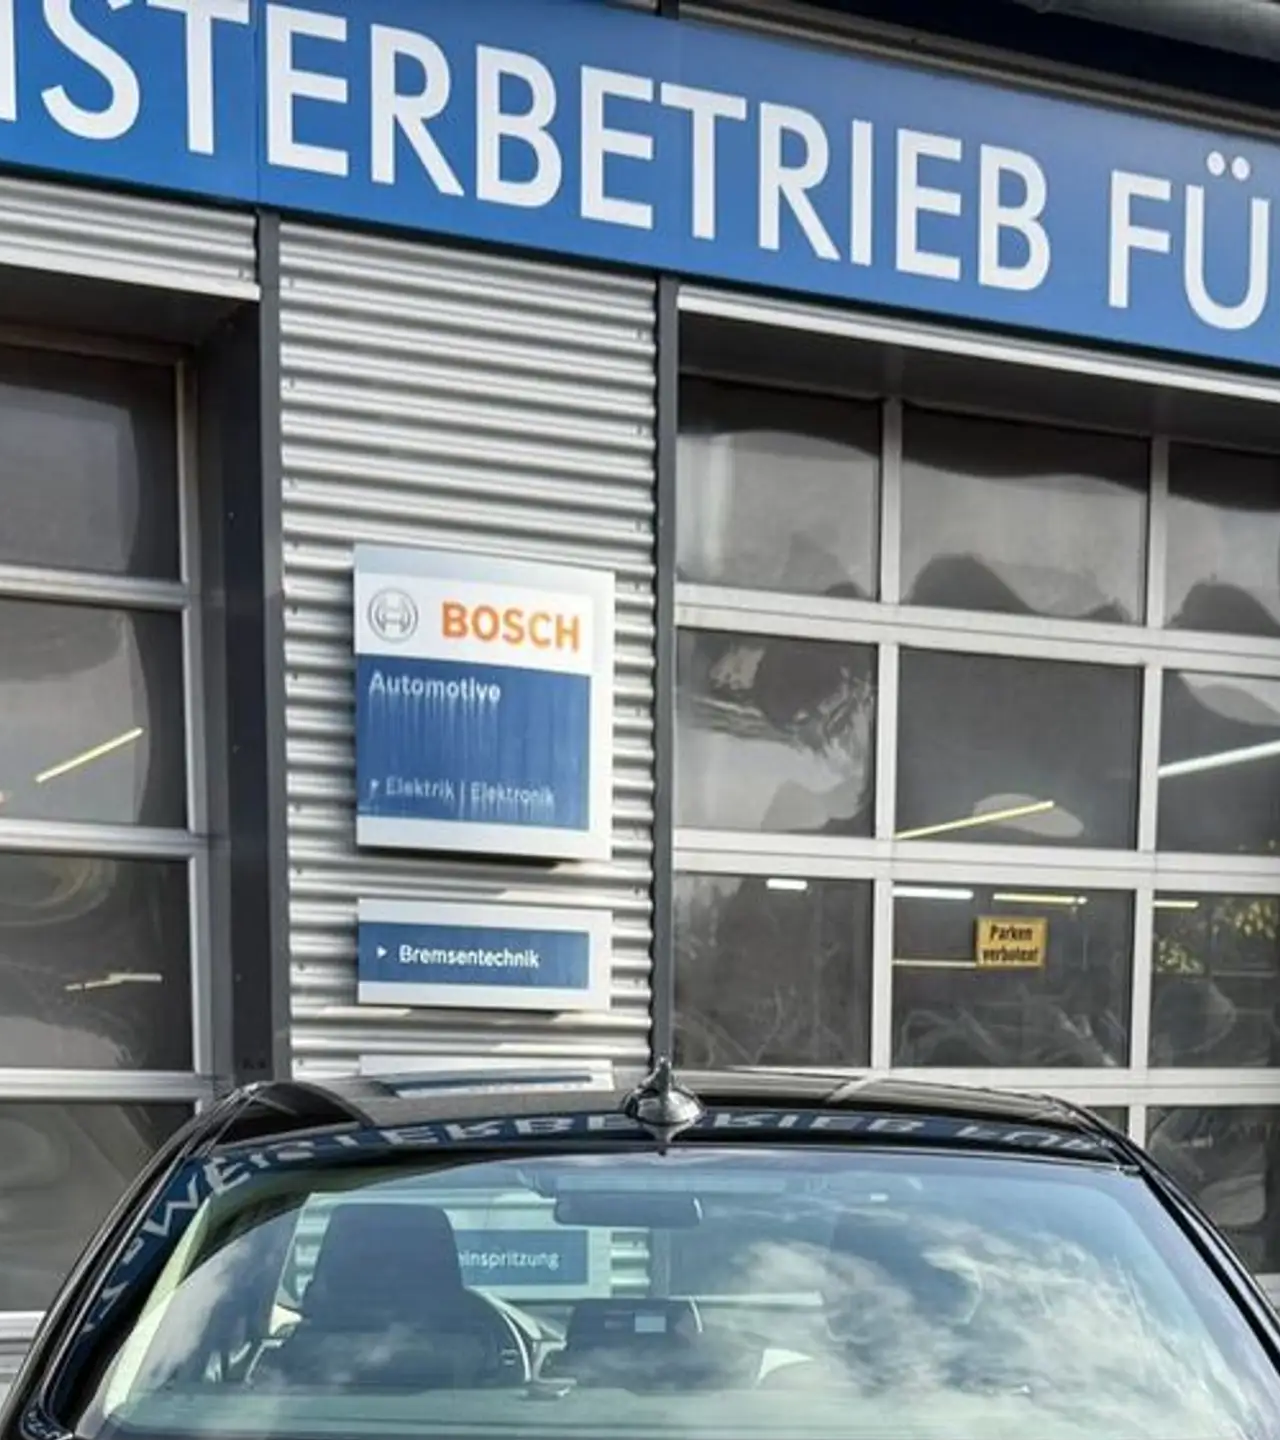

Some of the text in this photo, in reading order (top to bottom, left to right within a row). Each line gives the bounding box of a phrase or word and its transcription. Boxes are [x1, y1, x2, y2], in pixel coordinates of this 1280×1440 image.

[442, 601, 580, 652] BOSCH
[369, 669, 501, 702] Automotive
[385, 777, 555, 808] Elektrik Elektronik
[990, 924, 1033, 940] Parken
[398, 944, 541, 969] Bremsentechnik
